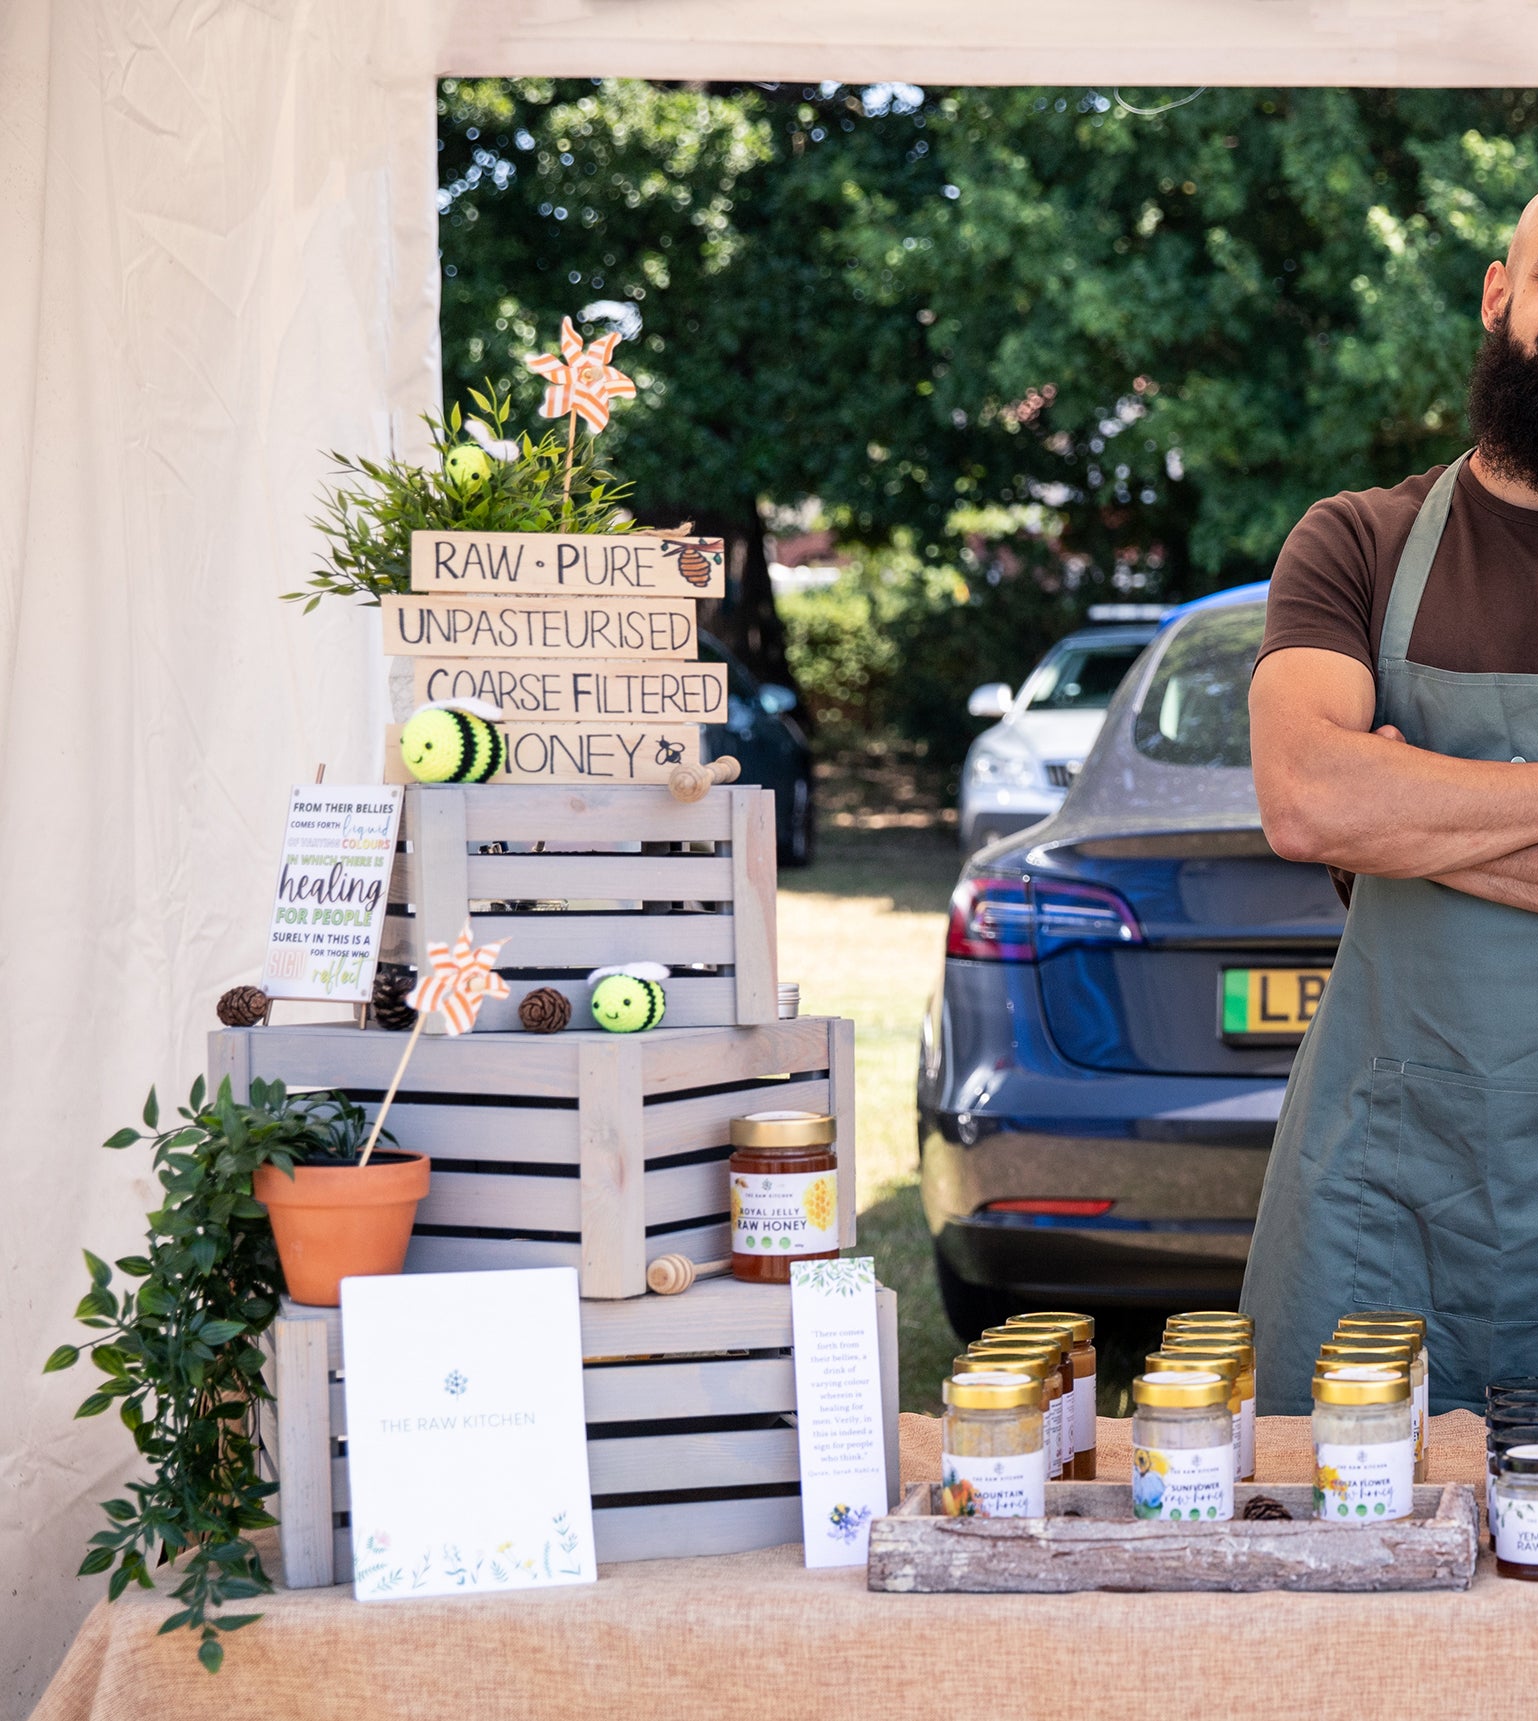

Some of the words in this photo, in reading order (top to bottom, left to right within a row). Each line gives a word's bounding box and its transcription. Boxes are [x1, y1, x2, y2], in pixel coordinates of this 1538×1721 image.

[435, 541, 524, 582] RAW
[557, 544, 657, 588] PURE
[398, 608, 692, 651] UNPASTEURISED
[427, 668, 562, 712] COARSE
[572, 672, 724, 714] FILTERED
[293, 803, 322, 813] FROM
[325, 803, 353, 813] THEIR
[355, 804, 394, 813] BELLIES
[290, 821, 315, 829] COMES
[343, 814, 391, 840] liquid
[341, 838, 390, 850] COLOURS
[340, 856, 372, 867] THERE
[374, 857, 385, 868] IS
[279, 862, 387, 912] healing
[276, 907, 308, 925] FOR
[311, 908, 373, 927] PEOPLE
[272, 932, 311, 943] SURELY
[313, 934, 325, 943] IN
[328, 934, 349, 944] THIS
[352, 935, 361, 945] IS
[363, 936, 371, 945] A
[310, 949, 325, 957] FOR
[327, 950, 349, 958] THOSE
[740, 1208, 767, 1216] ROYAL
[771, 1208, 799, 1216] JELLY
[737, 1219, 759, 1231] RAW
[762, 1219, 808, 1231] HONEY
[840, 1341, 860, 1349] from
[380, 1419, 412, 1433] THE
[417, 1416, 457, 1431] RAW
[463, 1411, 536, 1429] KITCHEN
[1171, 1482, 1220, 1492] SUNFLOWER
[974, 1490, 1024, 1500] MOUNTAIN
